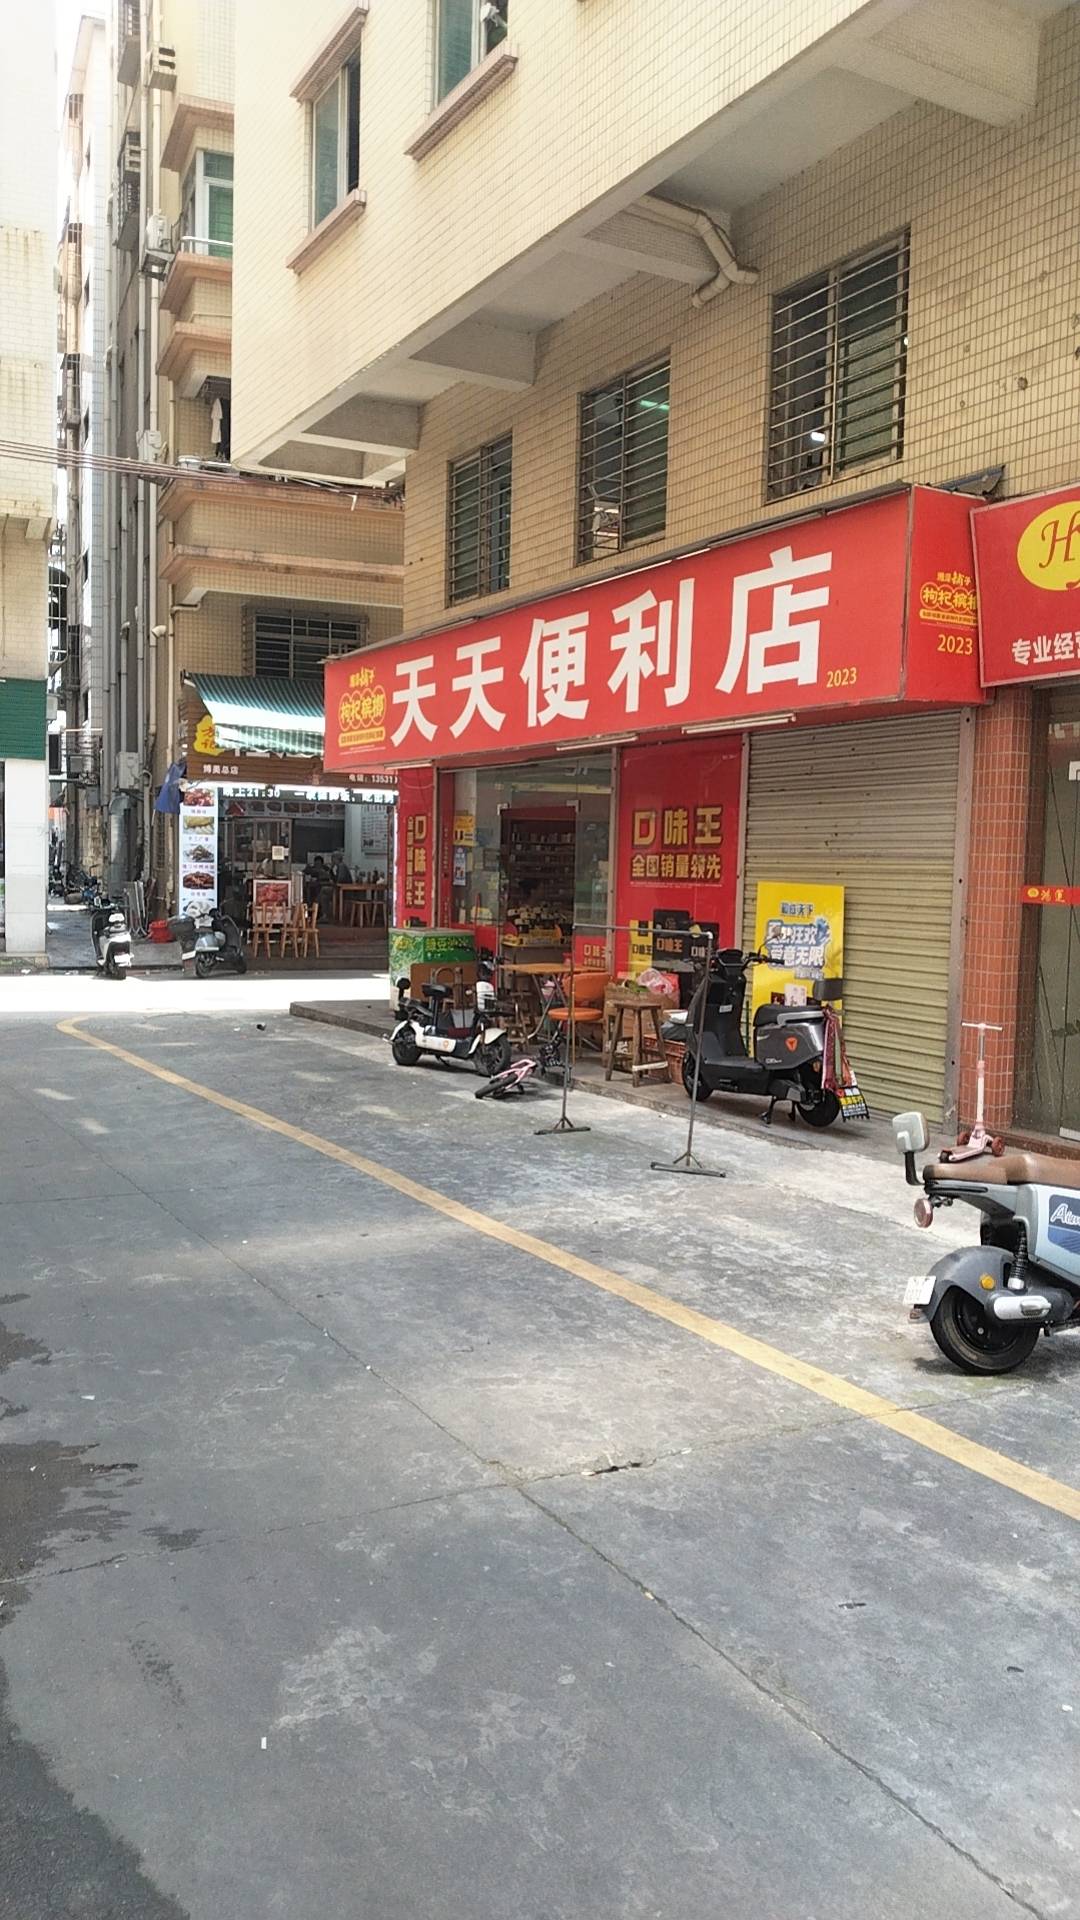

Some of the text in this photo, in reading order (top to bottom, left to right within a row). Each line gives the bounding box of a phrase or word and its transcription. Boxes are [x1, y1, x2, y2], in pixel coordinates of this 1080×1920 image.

[391, 546, 832, 747] 天天便利店
[937, 634, 974, 656] 2023
[825, 667, 858, 689] 2023
[633, 807, 723, 845] 口味王
[414, 815, 427, 906] 口味王
[631, 853, 721, 879] 全国销量领先
[632, 943, 652, 955] 口味王
[657, 937, 683, 953] 口味王
